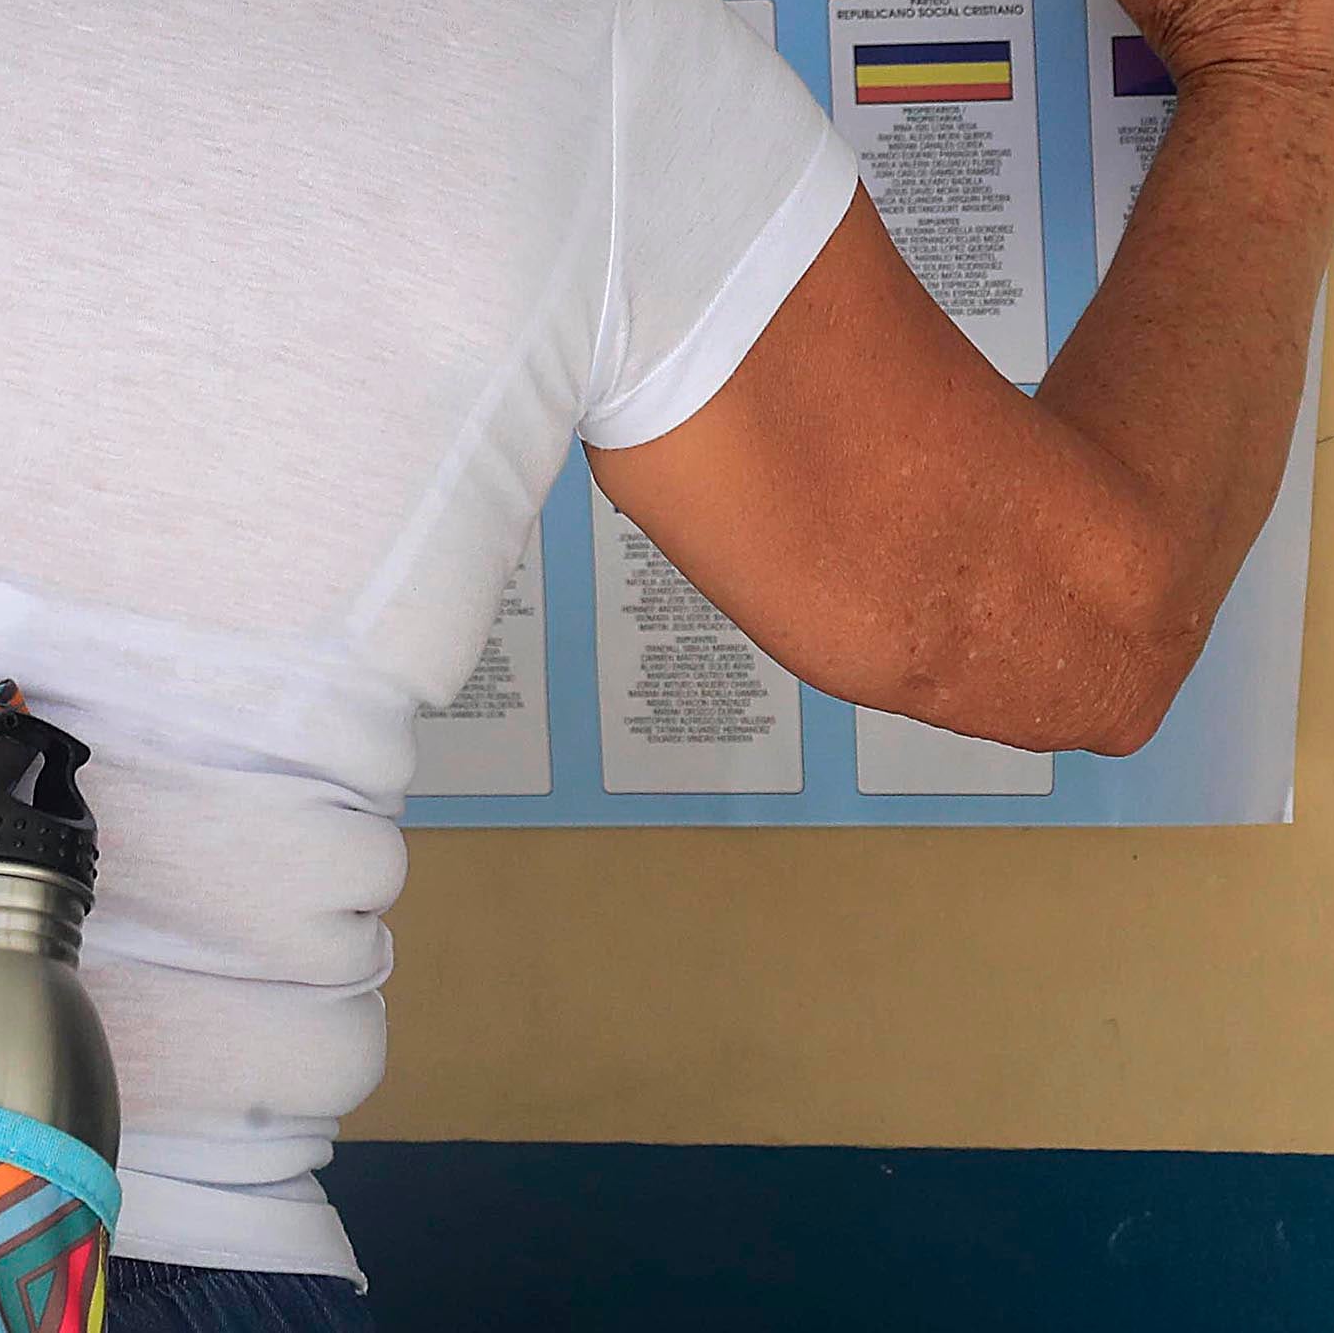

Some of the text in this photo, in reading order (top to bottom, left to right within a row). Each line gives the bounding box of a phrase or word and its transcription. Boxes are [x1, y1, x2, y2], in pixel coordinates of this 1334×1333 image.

[836, 4, 1024, 21] REPUBLICANO SOCIAL CRISTIANO
